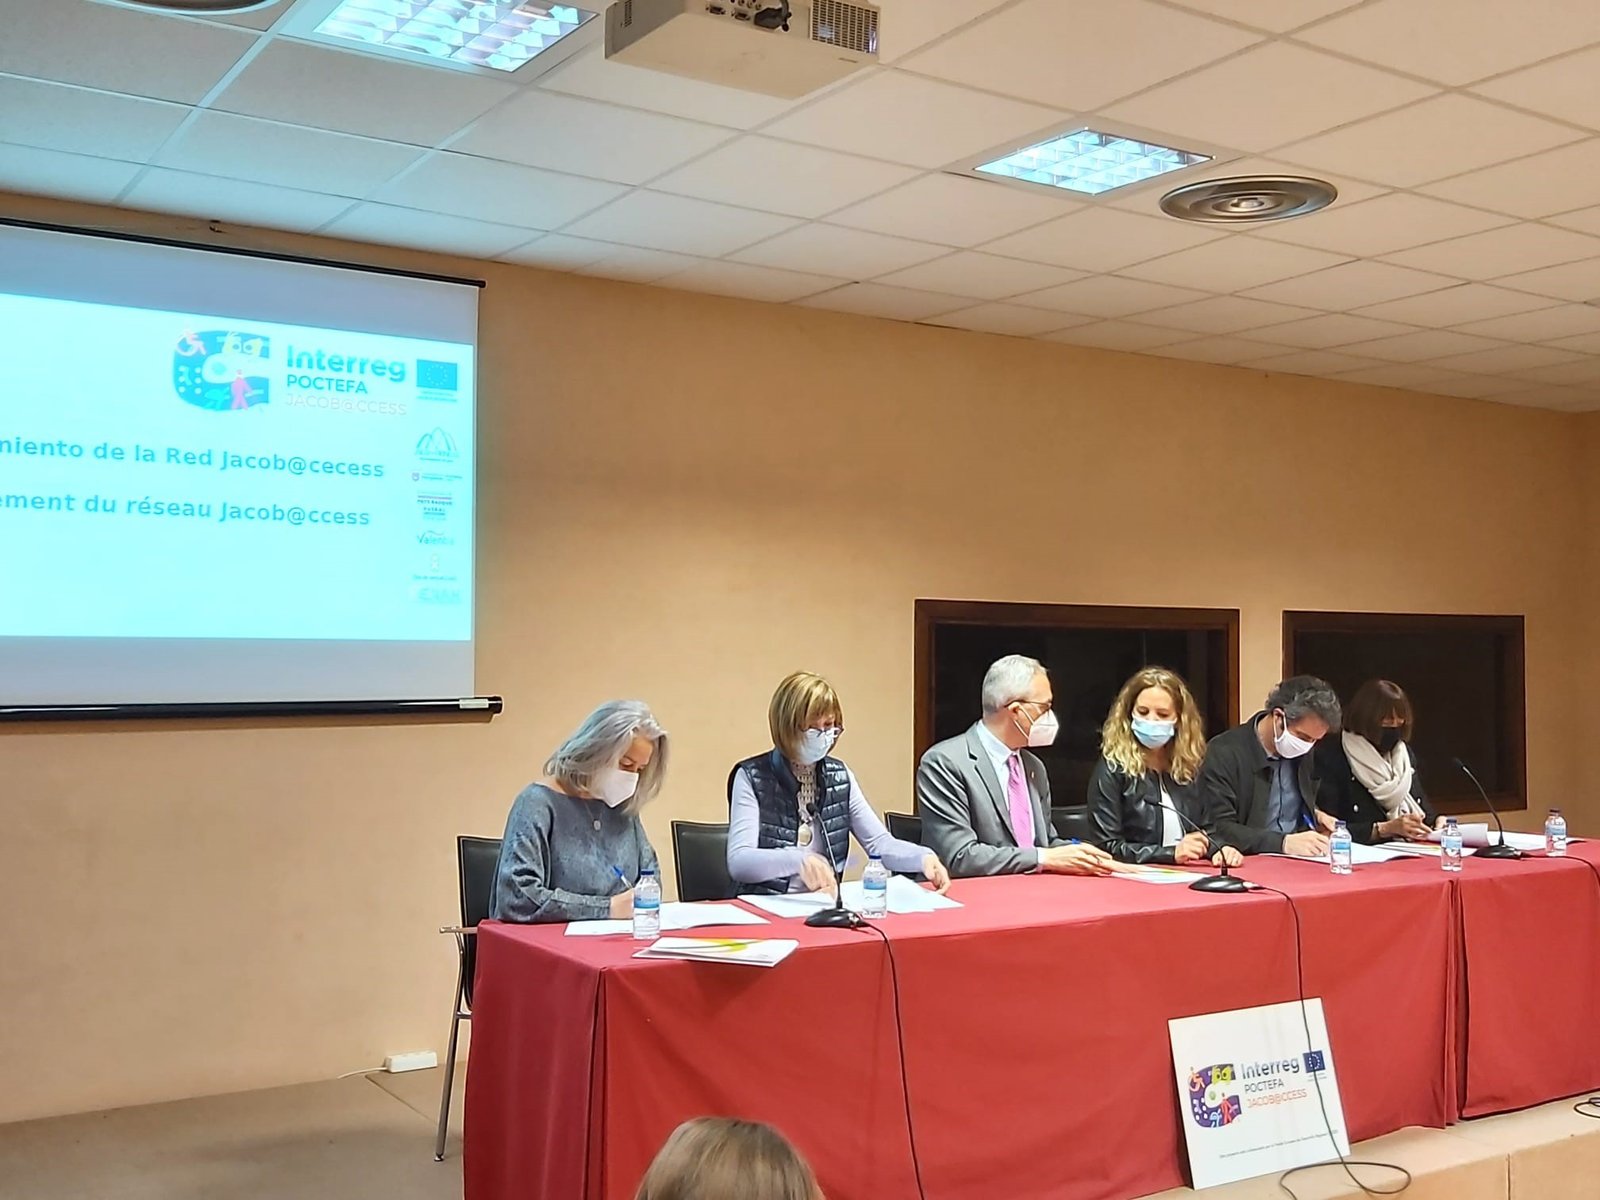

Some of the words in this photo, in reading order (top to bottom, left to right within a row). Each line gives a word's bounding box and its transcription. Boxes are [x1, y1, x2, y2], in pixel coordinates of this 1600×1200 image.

[286, 344, 407, 383] Interreg
[286, 374, 368, 395] POCTEFA
[285, 392, 408, 416] JACOB@CCESS
[93, 442, 125, 460] de
[135, 444, 156, 462] la
[166, 447, 212, 466] Red
[219, 450, 385, 478] Jacob@cecess
[0, 494, 76, 511] ment
[85, 494, 116, 513] du
[126, 496, 211, 518] réseau
[218, 501, 371, 526] Jacob@ccess
[1240, 1057, 1301, 1080] Interreg
[1244, 1078, 1285, 1094] POCTEFA
